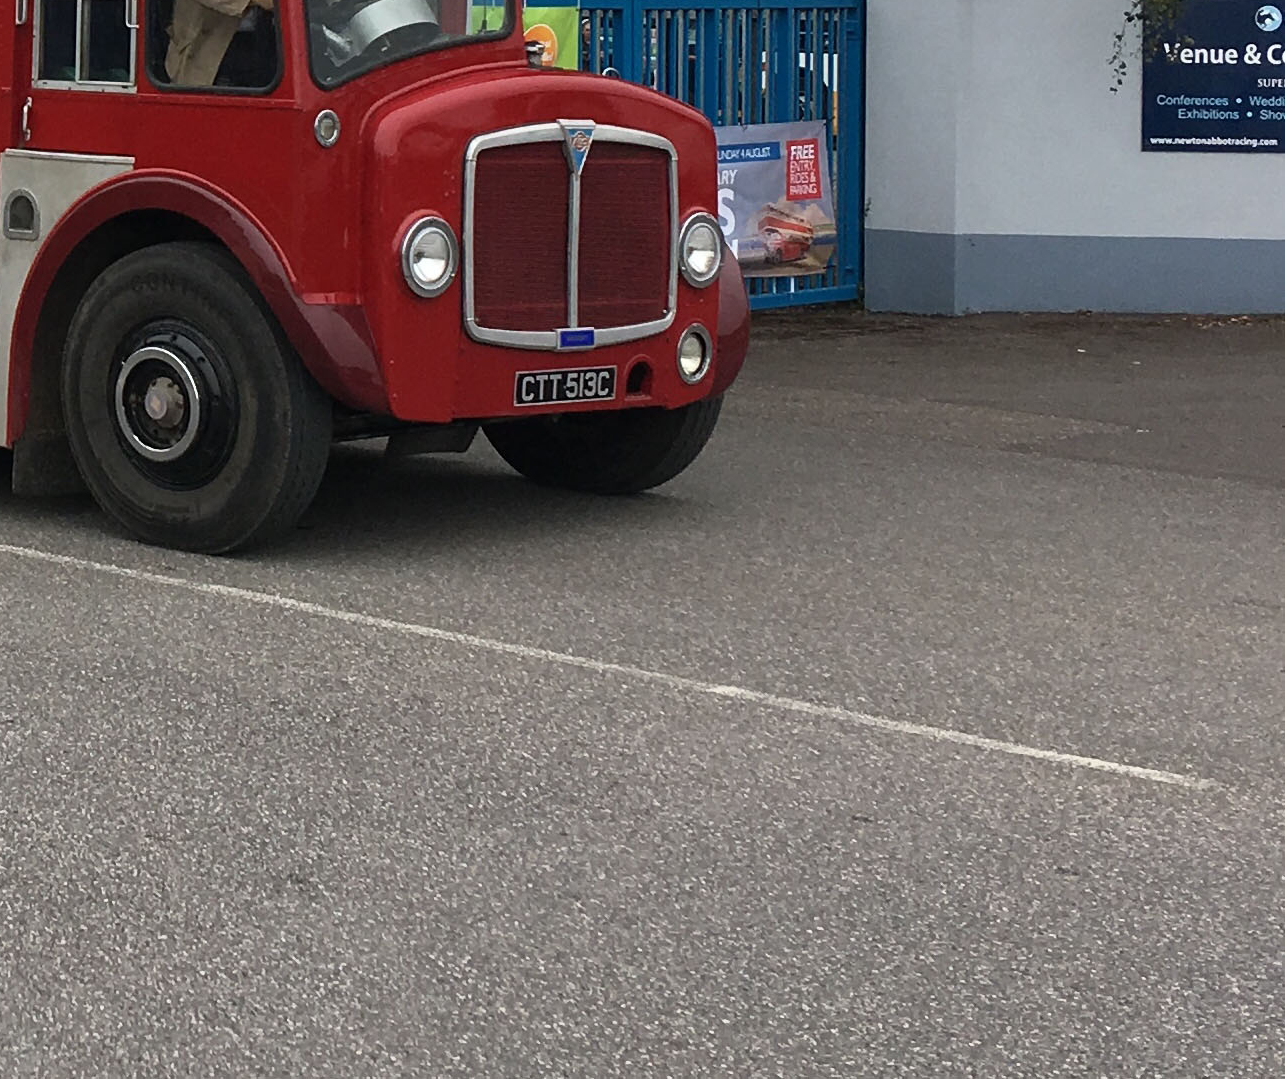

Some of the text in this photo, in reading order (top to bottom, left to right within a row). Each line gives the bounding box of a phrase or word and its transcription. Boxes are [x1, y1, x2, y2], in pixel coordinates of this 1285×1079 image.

[1164, 43, 1238, 64] Venue
[1244, 44, 1261, 64] &
[1257, 78, 1285, 88] SUPE
[1157, 95, 1229, 105] Conferences
[1178, 108, 1240, 120] Exhibitions
[1150, 137, 1279, 148] www.newtonabbotracing.com
[717, 149, 740, 161] UNDAY
[746, 146, 771, 158] AUGUST
[790, 144, 815, 161] FREE
[790, 172, 816, 184] RIDES &
[790, 184, 817, 195] PARKING
[522, 371, 610, 401] CTT 513C
